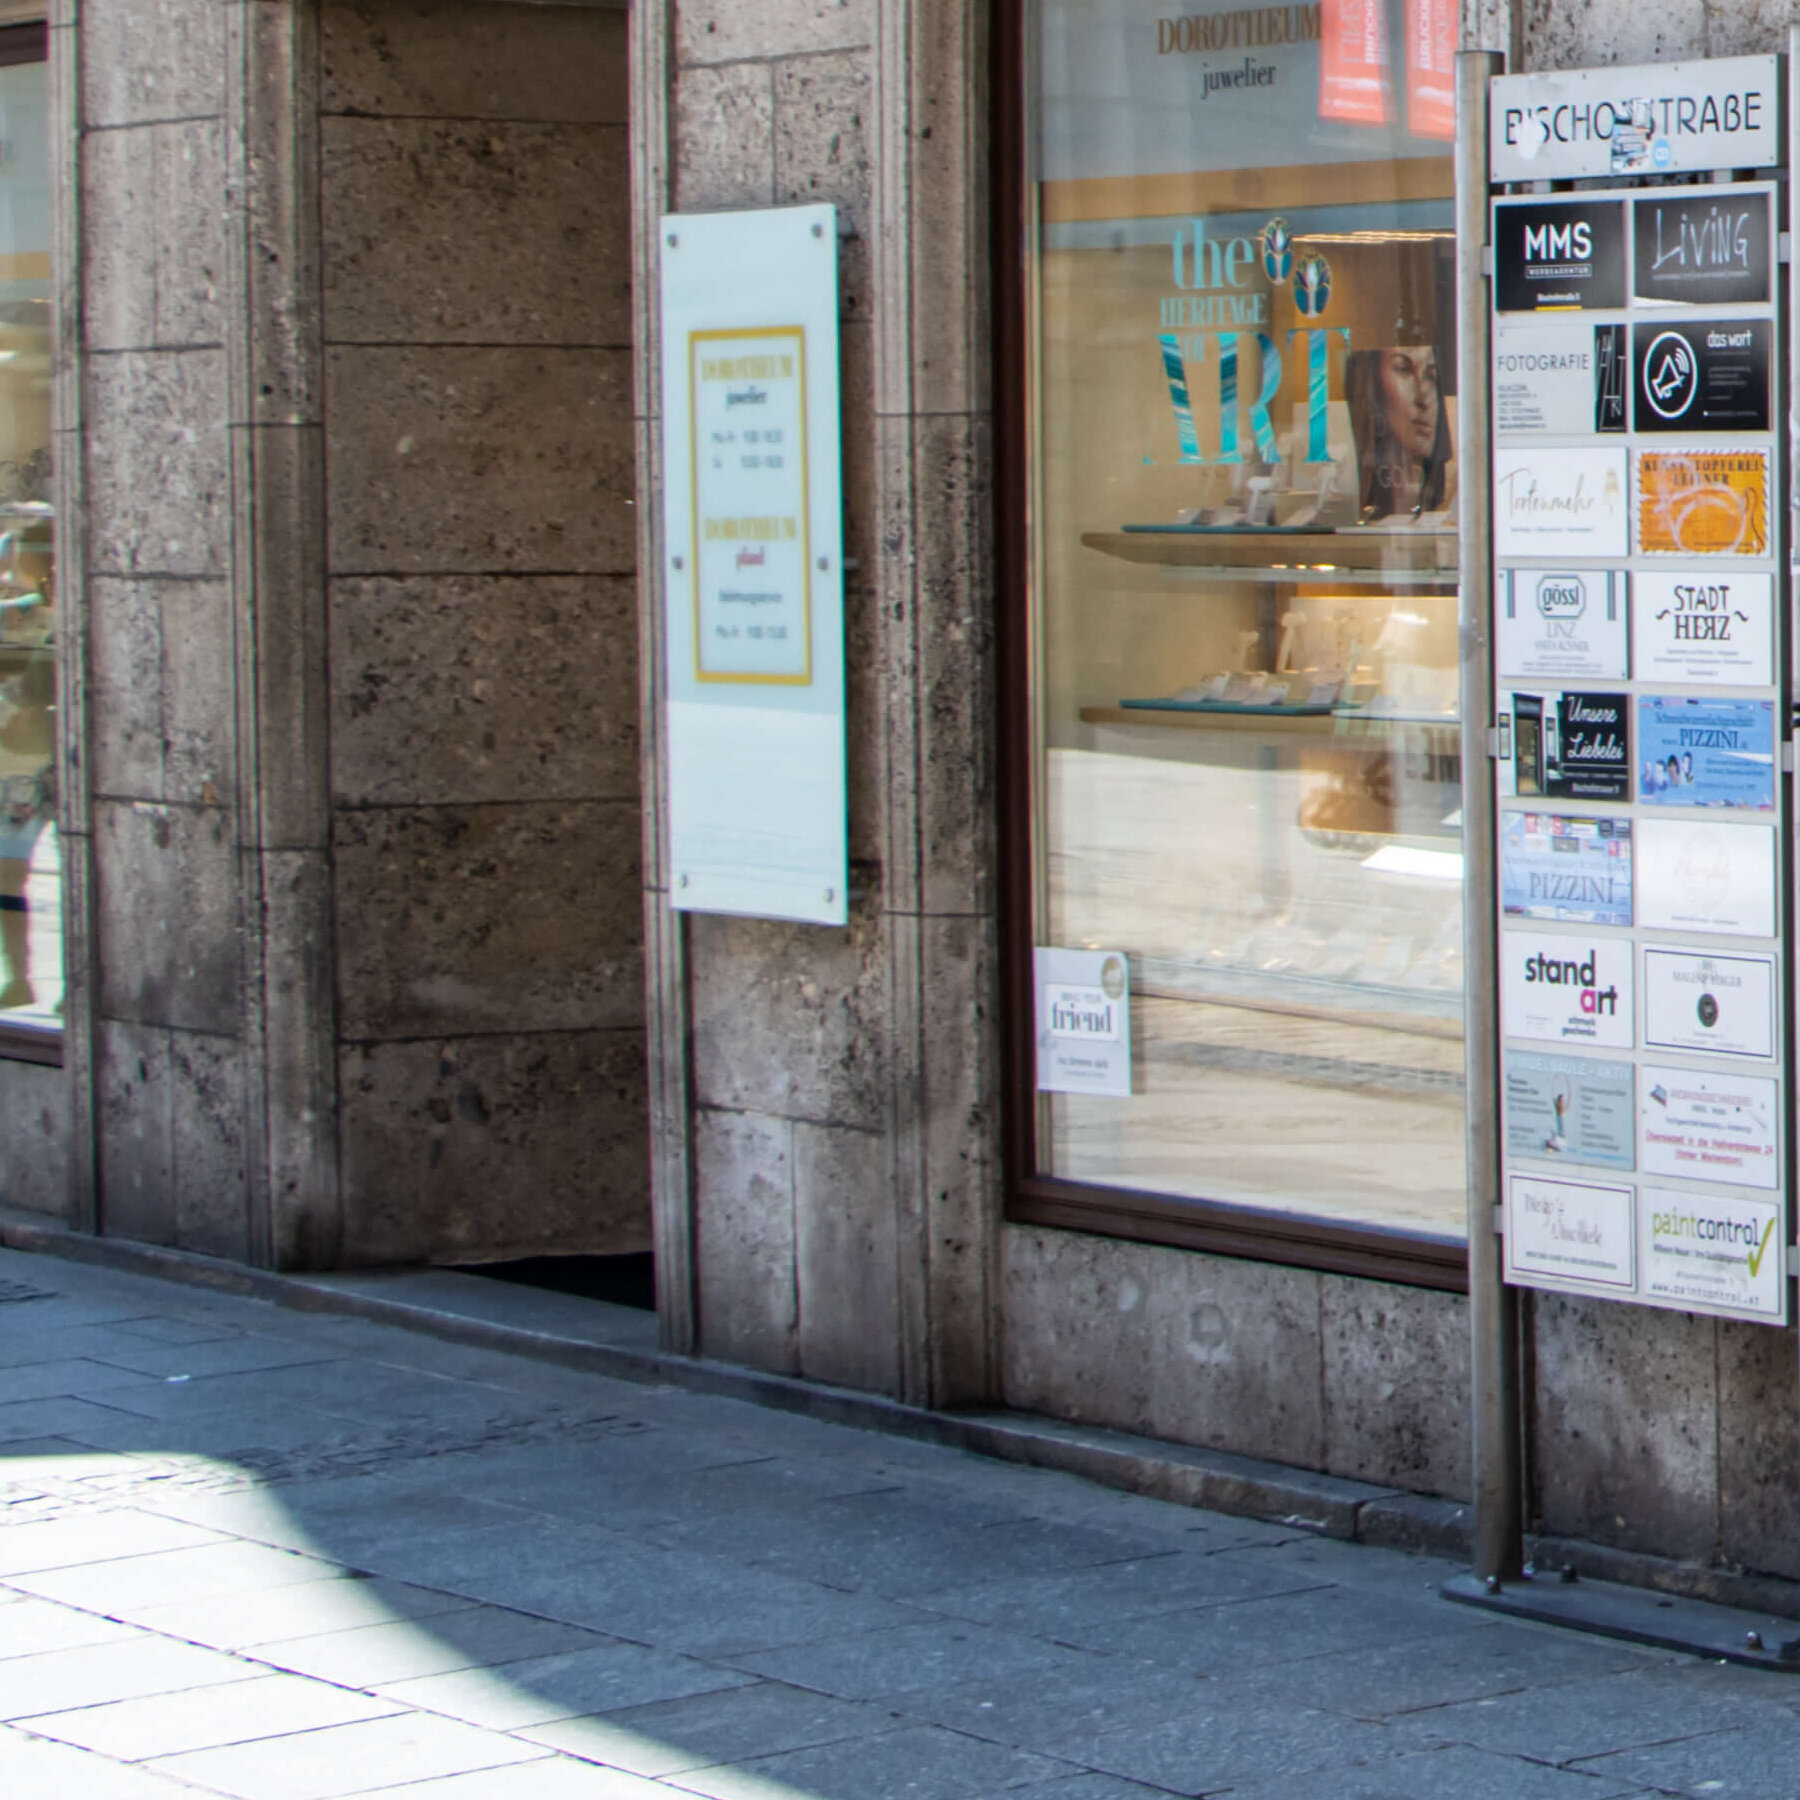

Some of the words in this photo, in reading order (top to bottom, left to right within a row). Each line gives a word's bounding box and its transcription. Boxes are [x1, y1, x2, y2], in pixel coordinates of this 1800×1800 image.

[1158, 3, 1322, 55] DOROTHEUM
[1201, 57, 1276, 100] juwelier
[1173, 219, 1254, 290] the
[1525, 221, 1592, 260] MMS
[1160, 293, 1269, 328] HERITAGE
[1497, 354, 1589, 371] FOTOGRAFIE
[1673, 585, 1730, 612] STADT
[1674, 614, 1731, 641] HERZ
[1529, 872, 1615, 904] PIZZINI
[1525, 949, 1596, 989] stand
[1051, 1000, 1111, 1034] friend
[1580, 986, 1618, 1016] art
[1653, 1206, 1760, 1246] paintcontrol
